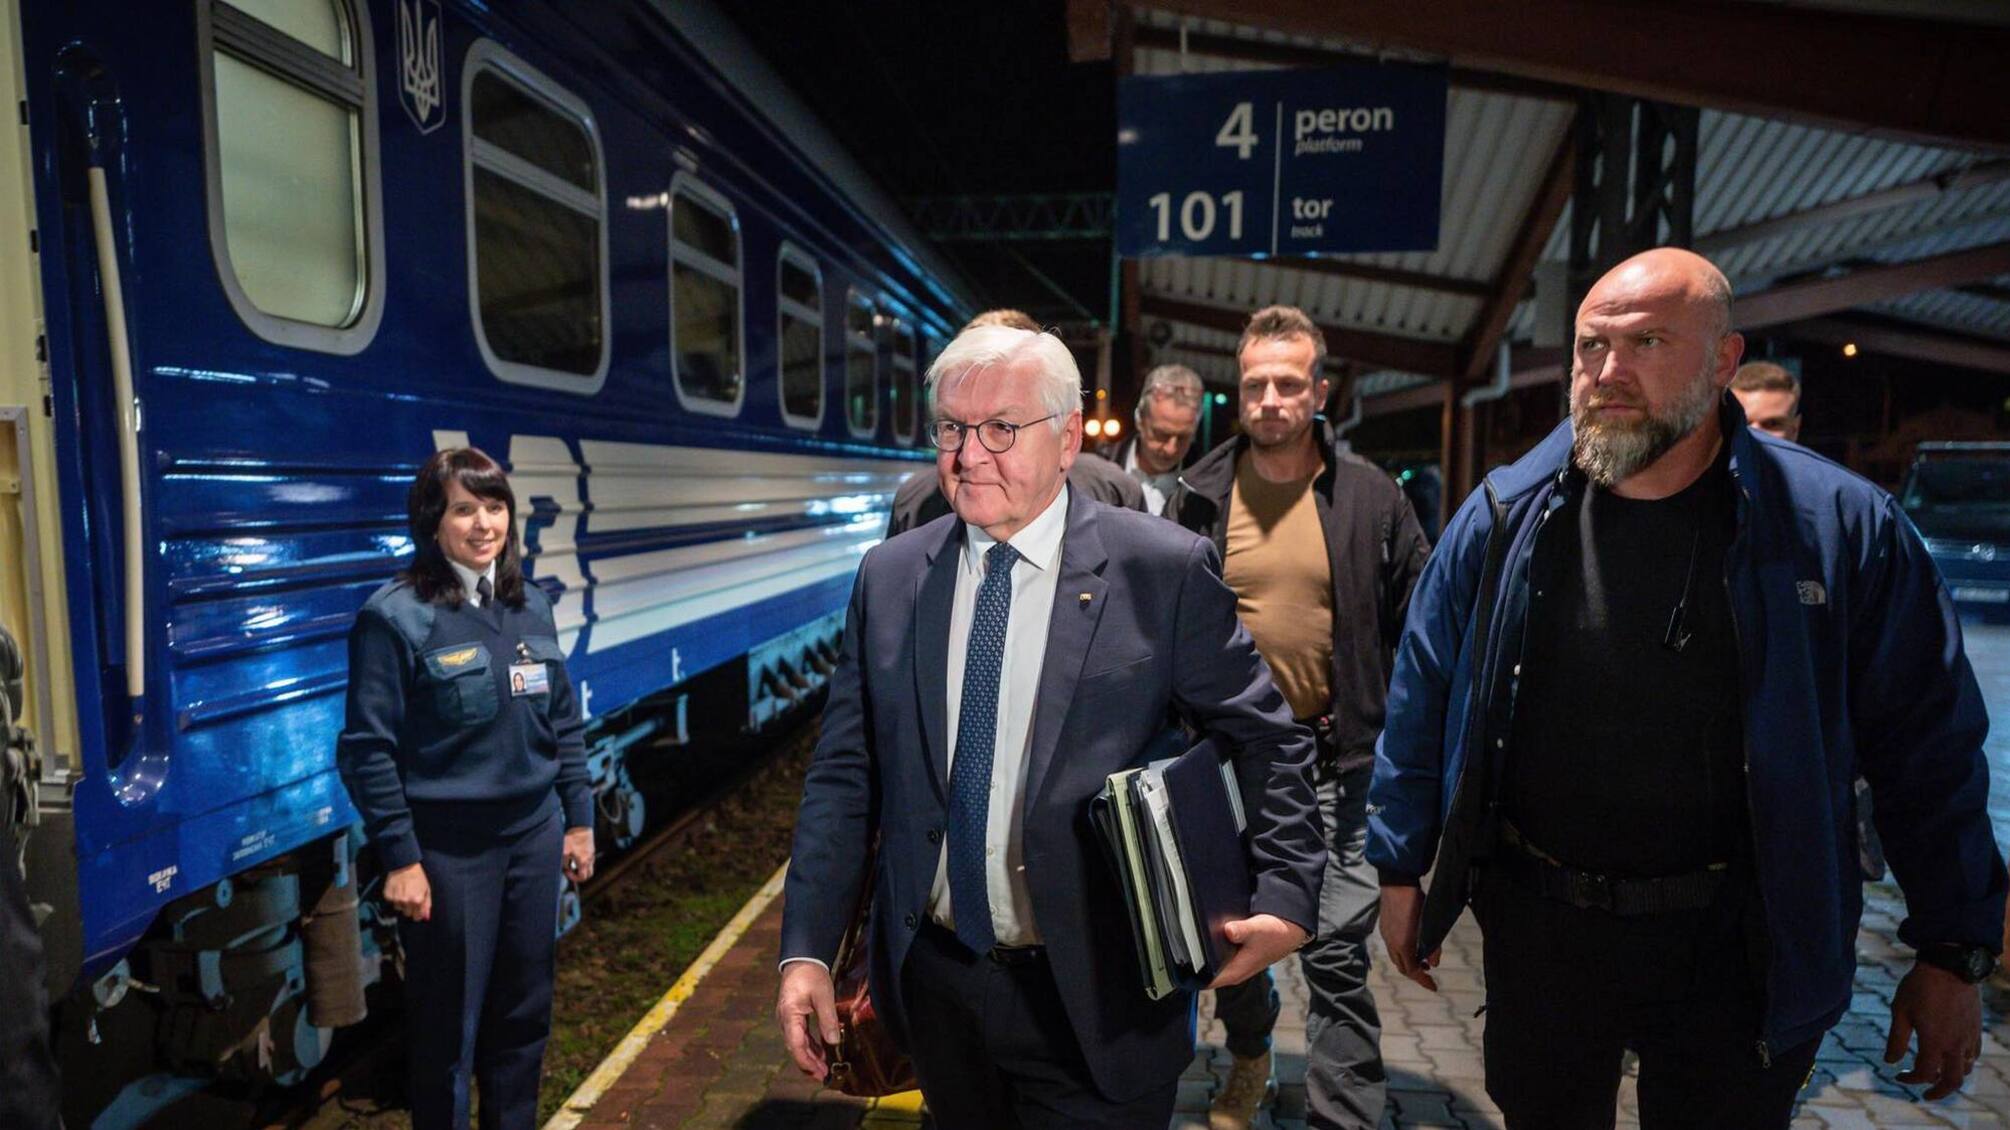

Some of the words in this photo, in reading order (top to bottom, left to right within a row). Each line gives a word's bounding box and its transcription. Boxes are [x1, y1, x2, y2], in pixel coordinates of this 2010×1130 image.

[1215, 101, 1259, 159] 4
[1295, 106, 1393, 141] peron
[1295, 136, 1363, 157] platform
[1149, 190, 1243, 241] 101
[1292, 197, 1334, 219] tor
